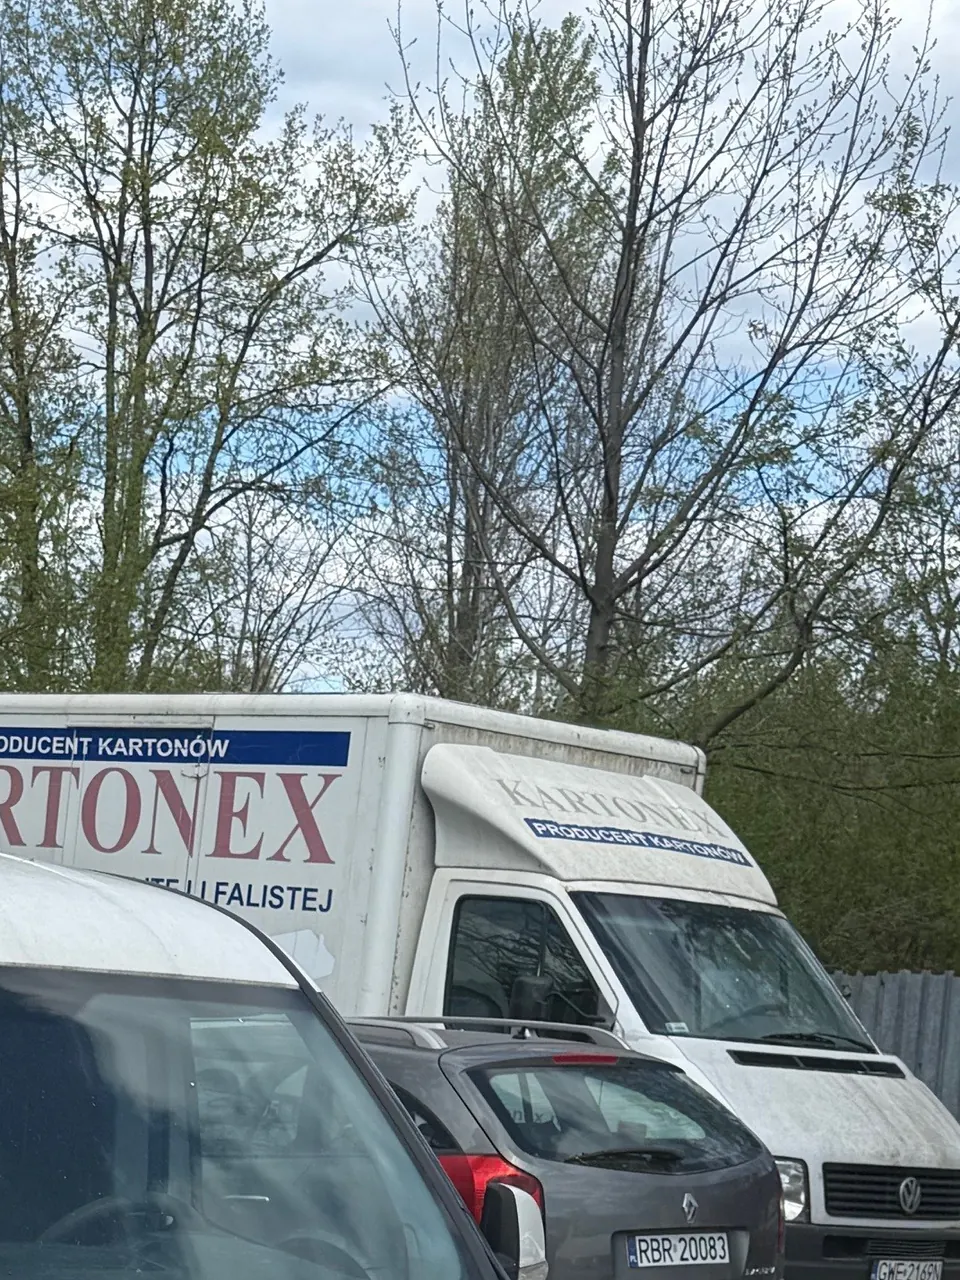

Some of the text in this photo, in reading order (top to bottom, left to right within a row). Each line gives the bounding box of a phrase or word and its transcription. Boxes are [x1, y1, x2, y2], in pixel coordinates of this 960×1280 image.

[98, 734, 229, 758] KARTONÓW
[535, 822, 746, 863] PRODUCENT KARTONÓW
[214, 882, 333, 912] FALISTEJ
[638, 1238, 673, 1263] RBR
[678, 1236, 726, 1261] 20083
